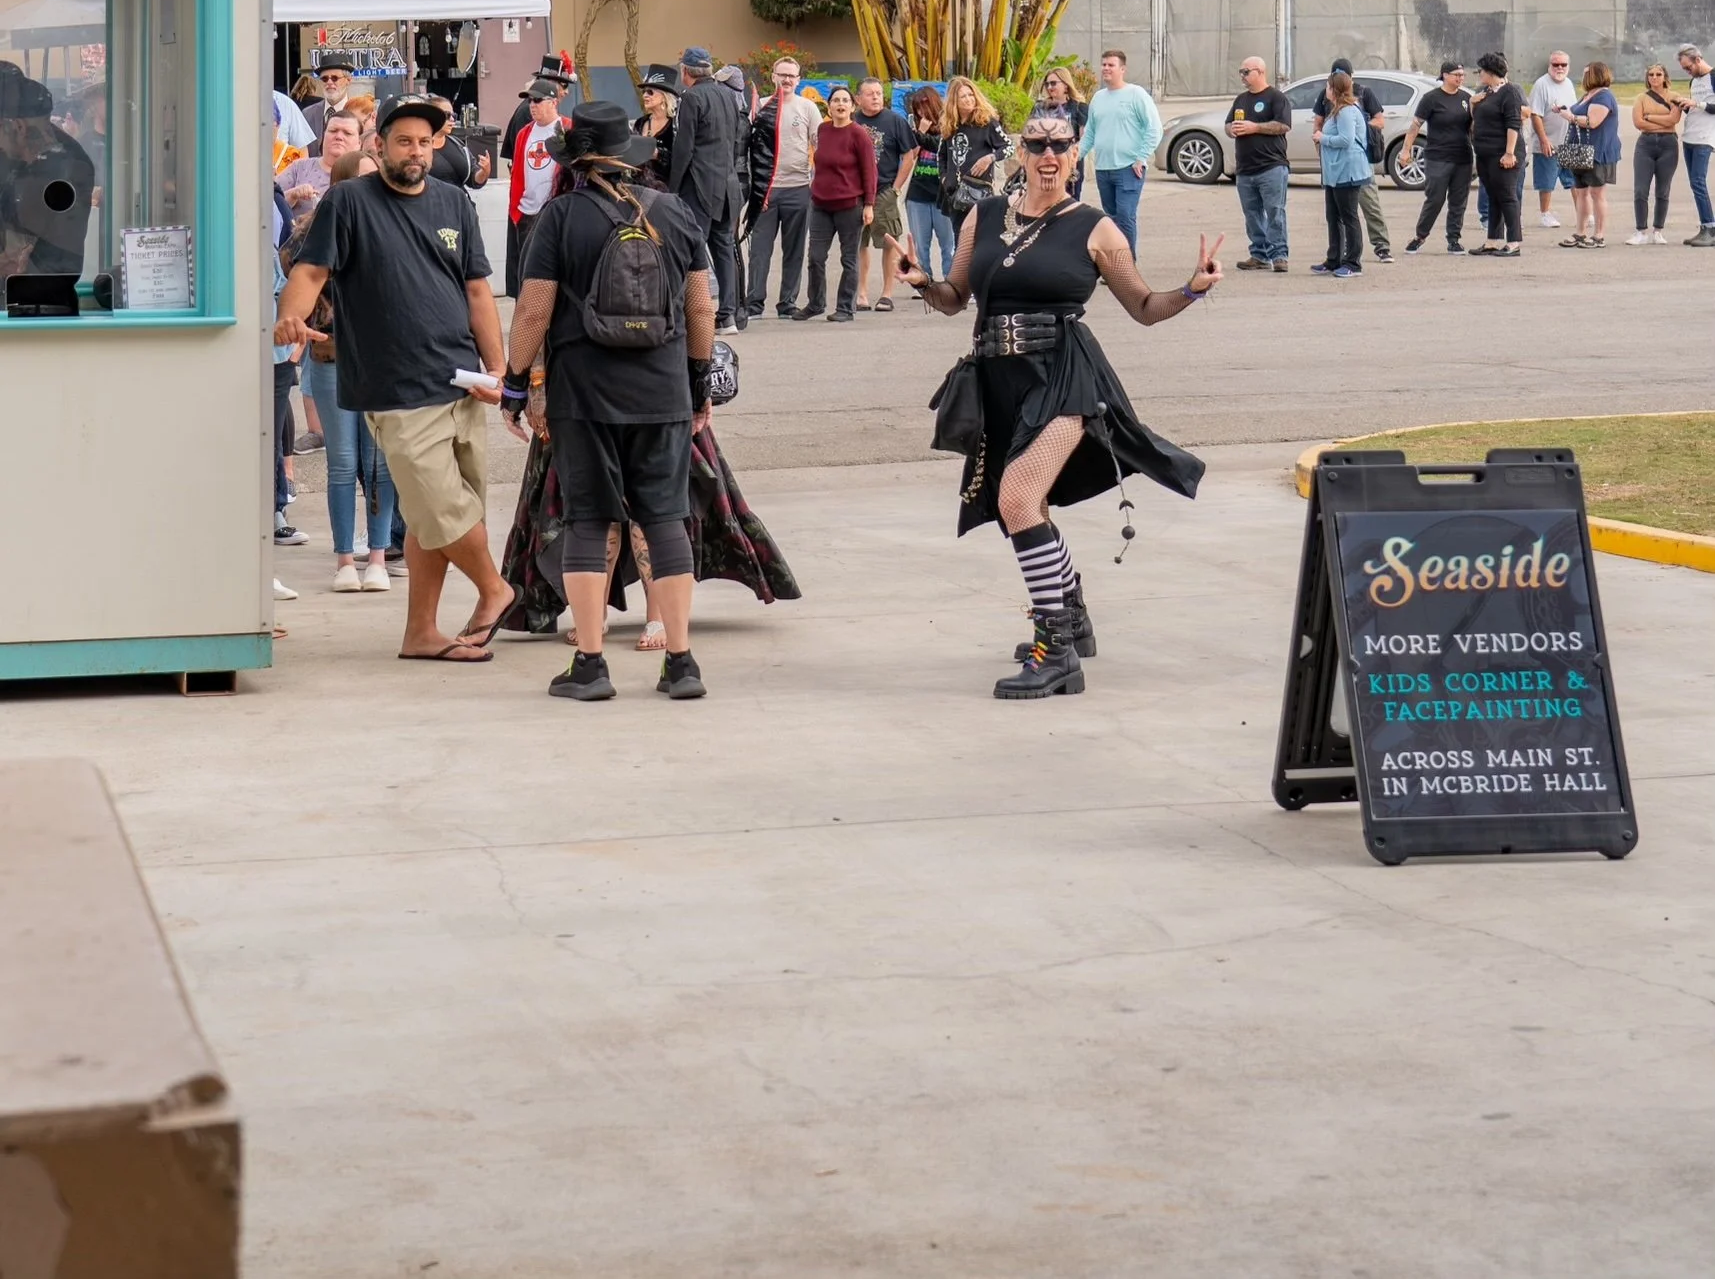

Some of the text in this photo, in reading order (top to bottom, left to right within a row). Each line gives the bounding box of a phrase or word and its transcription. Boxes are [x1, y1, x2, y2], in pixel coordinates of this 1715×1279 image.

[328, 27, 396, 46] Michelob
[309, 46, 408, 69] UTRA
[357, 69, 382, 77] LIGHT
[130, 249, 184, 260] TICKET PRICES
[1363, 535, 1571, 608] Seaside
[1364, 631, 1583, 655] MORE VENDORS
[1368, 670, 1589, 694] KIDS CORNER &
[1383, 697, 1583, 722] FACEPAINTING
[1381, 747, 1601, 771] ACROSS MAIN ST.
[1382, 772, 1608, 796] IN MCBRIDE HALL
